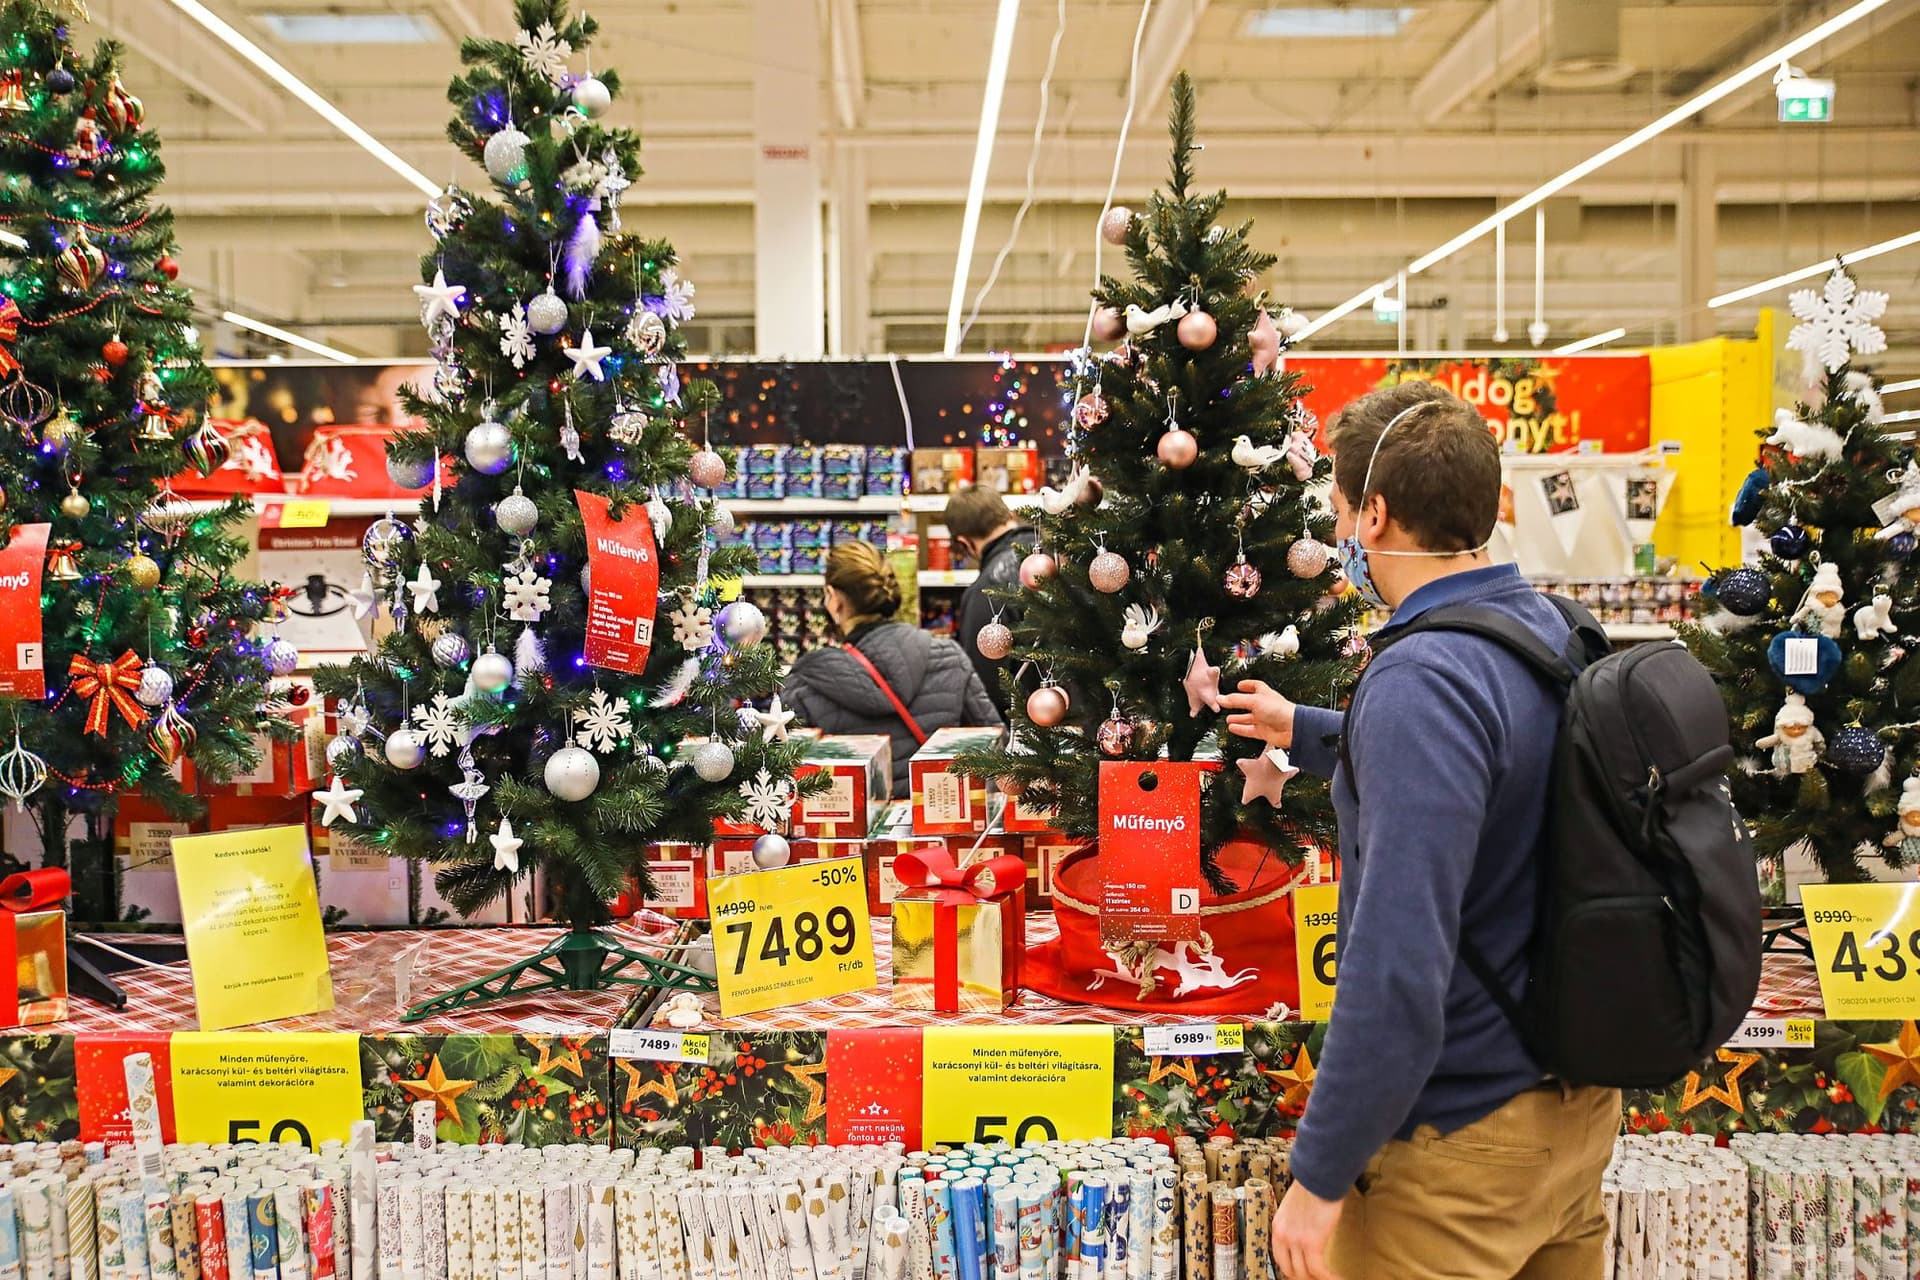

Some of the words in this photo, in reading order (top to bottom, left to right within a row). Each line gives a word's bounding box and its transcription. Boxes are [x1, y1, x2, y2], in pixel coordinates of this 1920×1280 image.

[1400, 371, 1537, 415] ldog
[1486, 410, 1581, 454] onyt!
[597, 537, 649, 564] Műfenyő
[0, 572, 30, 590] nyő
[637, 623, 649, 641] E1
[25, 648, 34, 664] F
[1113, 814, 1186, 834] Műfenyő
[812, 866, 857, 887] -50%
[1179, 894, 1192, 909] D
[716, 899, 756, 917] 14990
[1304, 912, 1338, 927] 1399
[1814, 910, 1852, 923] 8990
[726, 906, 856, 975] 7489
[839, 960, 863, 972] Ft/db
[1313, 934, 1337, 986] 6
[1216, 1029, 1241, 1037] Akció
[1744, 1026, 1775, 1037] 4399
[1787, 1024, 1812, 1032] Akció
[640, 1038, 670, 1050] 7489
[682, 1039, 707, 1048] Akció
[1174, 1032, 1204, 1044] 6989
[972, 1048, 1007, 1057] Minden
[219, 1055, 254, 1063] Minden
[181, 1066, 230, 1076] karácsonyi
[253, 1066, 264, 1075] és
[265, 1065, 297, 1075] beltéri
[933, 1060, 982, 1072] karácsonyi
[1005, 1061, 1016, 1070] és
[1018, 1060, 1049, 1070] beltéri
[217, 1078, 257, 1087] valamint
[259, 1077, 315, 1087] dekorációra
[968, 1074, 1008, 1083] valamint
[1010, 1073, 1066, 1083] dekorációra
[875, 1123, 905, 1132] nekünk
[848, 1133, 874, 1142] fontos
[877, 1134, 887, 1142] az
[889, 1132, 902, 1142] Ön
